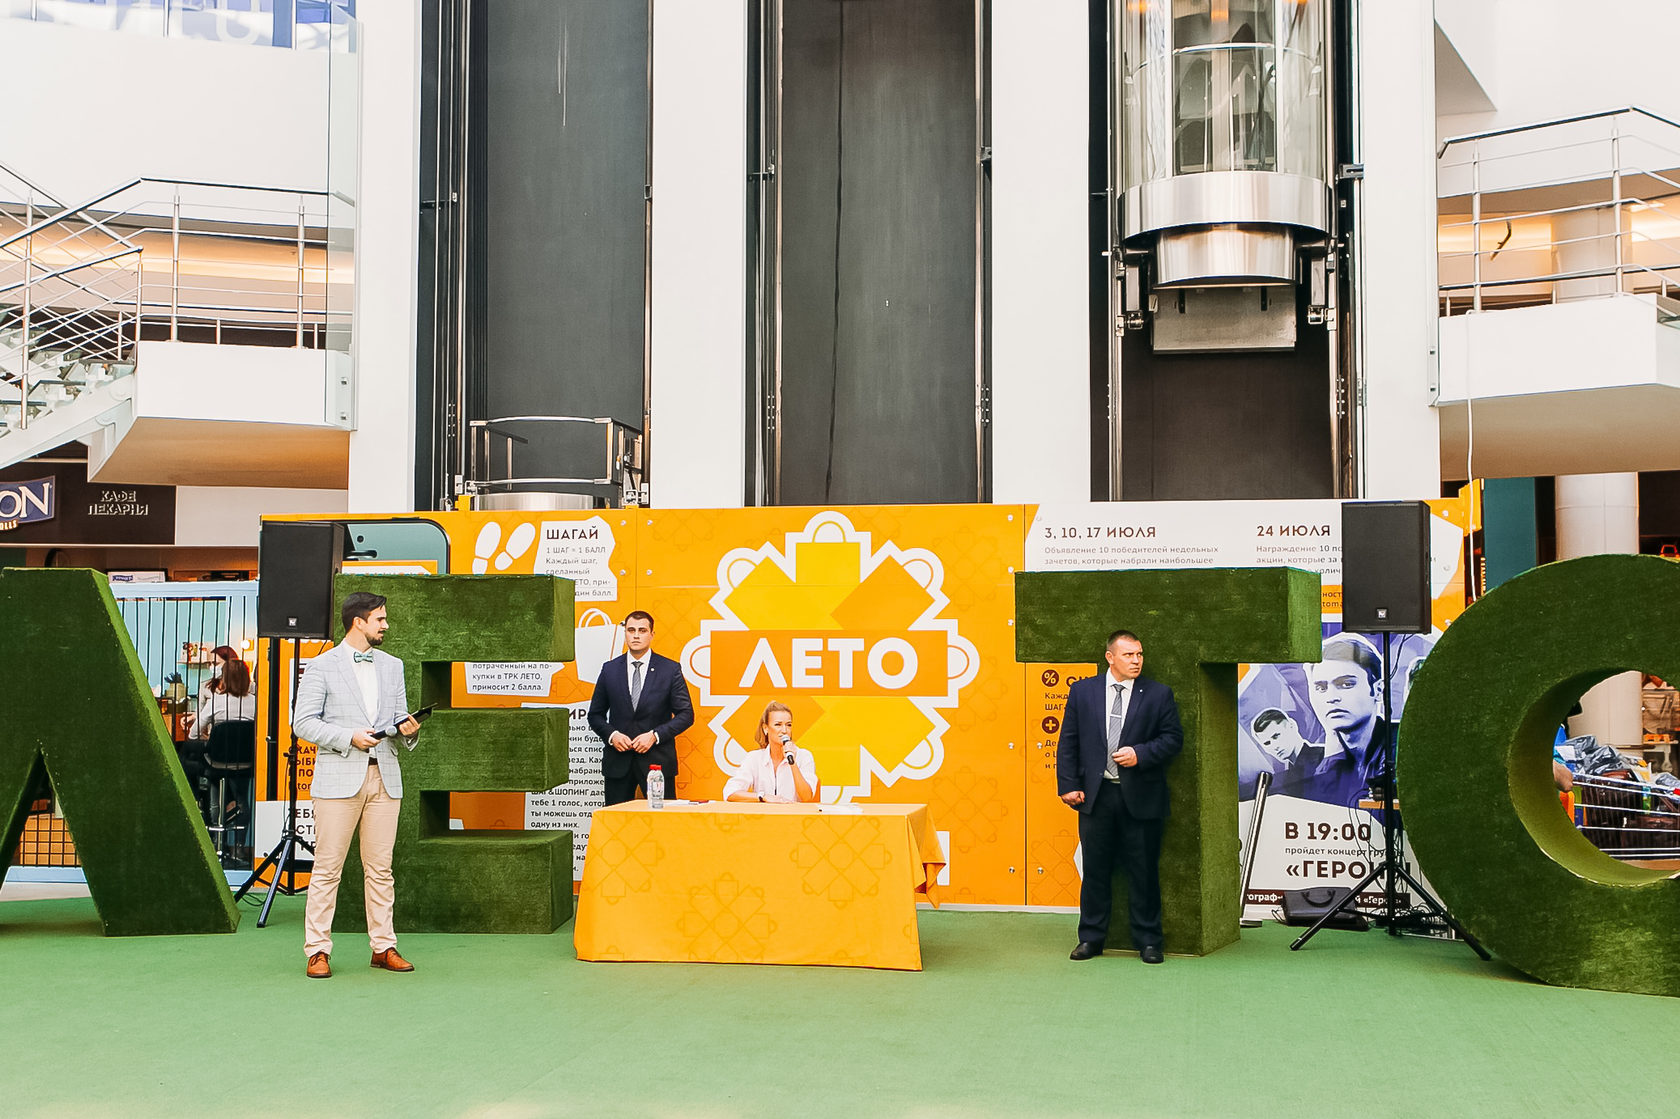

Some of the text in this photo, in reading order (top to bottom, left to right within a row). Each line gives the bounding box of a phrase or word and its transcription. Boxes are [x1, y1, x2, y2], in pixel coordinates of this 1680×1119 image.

[0, 482, 50, 518] ON
[101, 490, 137, 502] КАФЕ
[88, 503, 149, 516] ПЕКАРНЯ
[546, 525, 599, 540] ШАГАЙ
[1044, 526, 1157, 540] 3, 10, 17 ИЮЛЯ
[1256, 524, 1331, 537] 24 ИЮЛЯ
[552, 546, 570, 554] ШАГ
[585, 546, 607, 554] БАЛЛ
[1044, 545, 1219, 555] Объявление 10 победителей недельных
[1256, 545, 1317, 554] Награждение
[545, 557, 580, 565] Каждый
[1044, 556, 1214, 566] зачетов, которые набрали наибольшее
[1256, 557, 1286, 565] акции,
[1287, 556, 1326, 566] которые
[545, 568, 591, 576] сделанный
[592, 579, 611, 587] при-
[472, 662, 527, 670] потраченный
[738, 637, 919, 690] ЛЕТО
[472, 673, 496, 682] купки
[503, 672, 519, 680] ТРК
[520, 672, 543, 681] ЛЕТО,
[472, 683, 510, 692] приносит
[517, 683, 544, 691] балла.
[1045, 692, 1069, 700] Кажд
[1045, 703, 1066, 711] ШАГ
[569, 708, 587, 720] ИР
[584, 746, 604, 754] спис
[298, 768, 314, 778] ПО
[569, 779, 605, 787] приложе
[530, 799, 550, 807] тебе
[558, 800, 583, 808] голос,
[295, 808, 315, 819] ЕБ
[530, 810, 542, 818] ты
[296, 824, 316, 835] СТ
[530, 821, 551, 829] одну
[1285, 822, 1372, 841] В 19:00
[1285, 847, 1386, 858] пройдет концерт гру
[1286, 860, 1411, 880] «ГЕРО
[1247, 892, 1284, 903] ограф-
